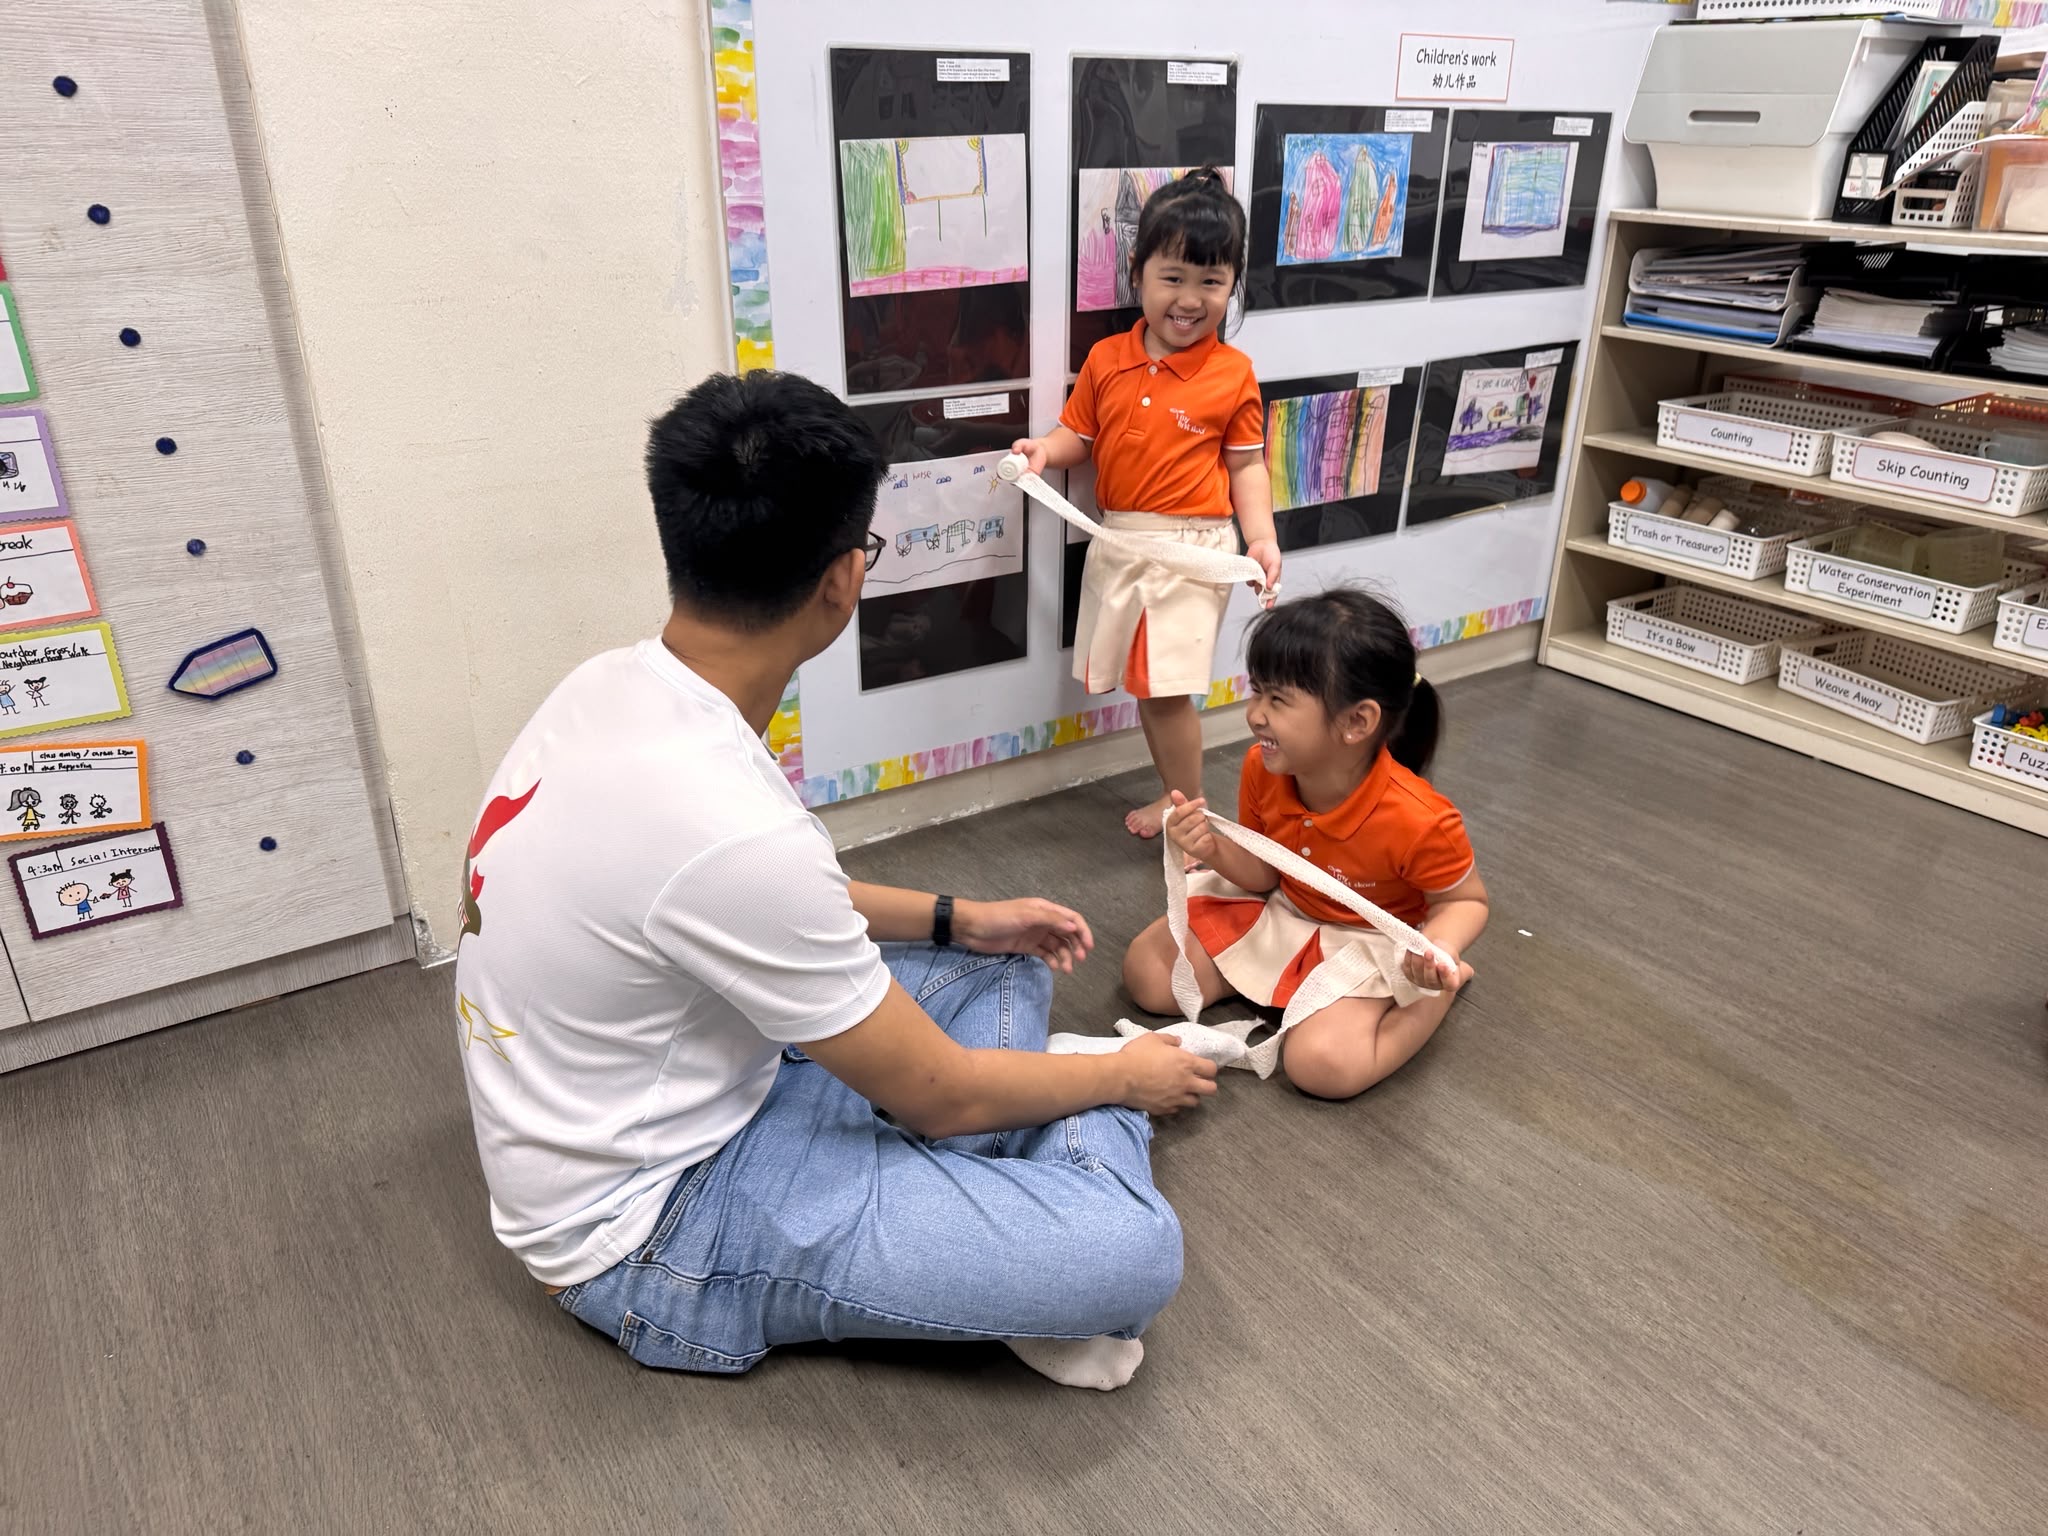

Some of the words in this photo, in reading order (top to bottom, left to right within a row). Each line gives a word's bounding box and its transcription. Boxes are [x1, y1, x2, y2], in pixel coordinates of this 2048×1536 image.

[1416, 48, 1469, 66] Children's
[1471, 50, 1497, 67] work
[1432, 73, 1477, 91] 幼儿作品
[1710, 427, 1754, 448] Counting
[1877, 459, 1906, 479] Skip
[1909, 465, 1970, 491] Counting
[1632, 525, 1658, 541] Trash
[1660, 533, 1672, 542] or
[1674, 534, 1725, 555] Treasure?
[1818, 563, 1854, 580] Water
[1856, 573, 1931, 600] Conservation
[1837, 582, 1903, 607] Experiment
[2036, 618, 2048, 631] E
[1646, 629, 1665, 643] It's
[1666, 637, 1673, 646] a
[1675, 637, 1696, 653] Bow
[1815, 675, 1850, 697] Weave
[1852, 691, 1882, 711] Away
[2019, 751, 2048, 771] Puz
[71, 852, 107, 867] Social
